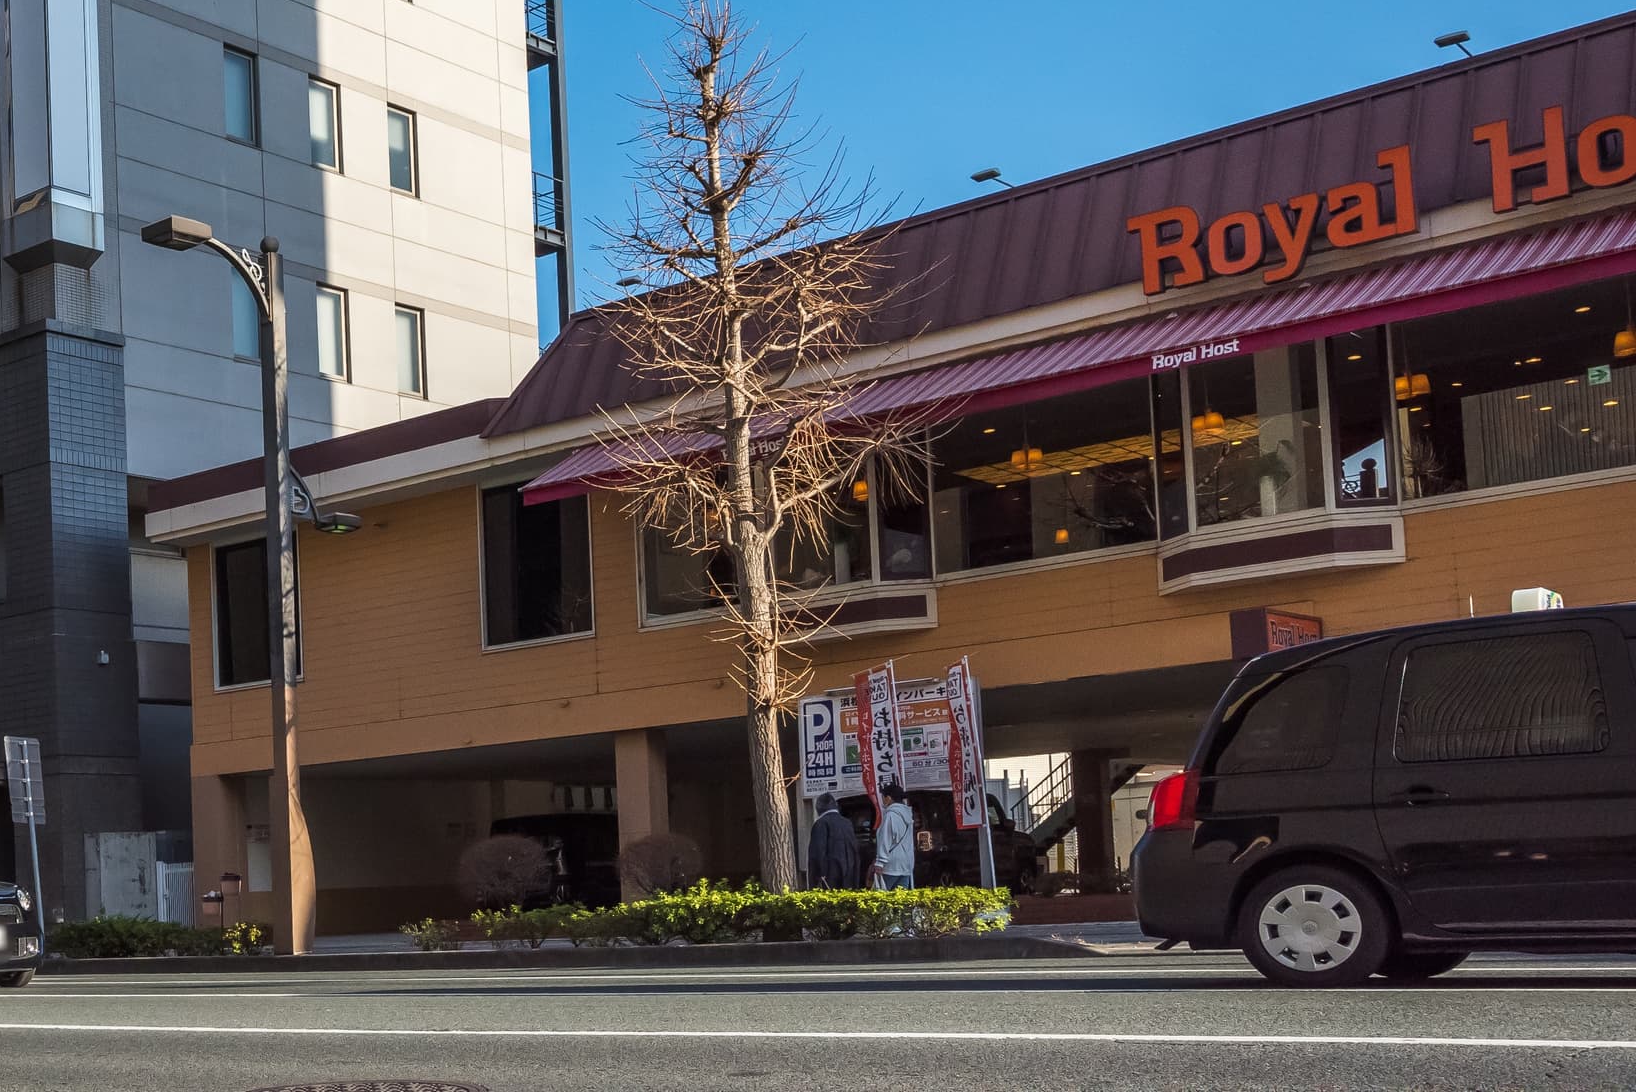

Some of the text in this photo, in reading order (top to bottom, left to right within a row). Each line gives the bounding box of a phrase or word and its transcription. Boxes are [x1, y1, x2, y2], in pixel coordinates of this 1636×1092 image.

[1126, 105, 1636, 296] Royal Ho
[1151, 338, 1240, 369] Royal Host
[805, 703, 832, 752] P
[806, 751, 834, 767] 24H
